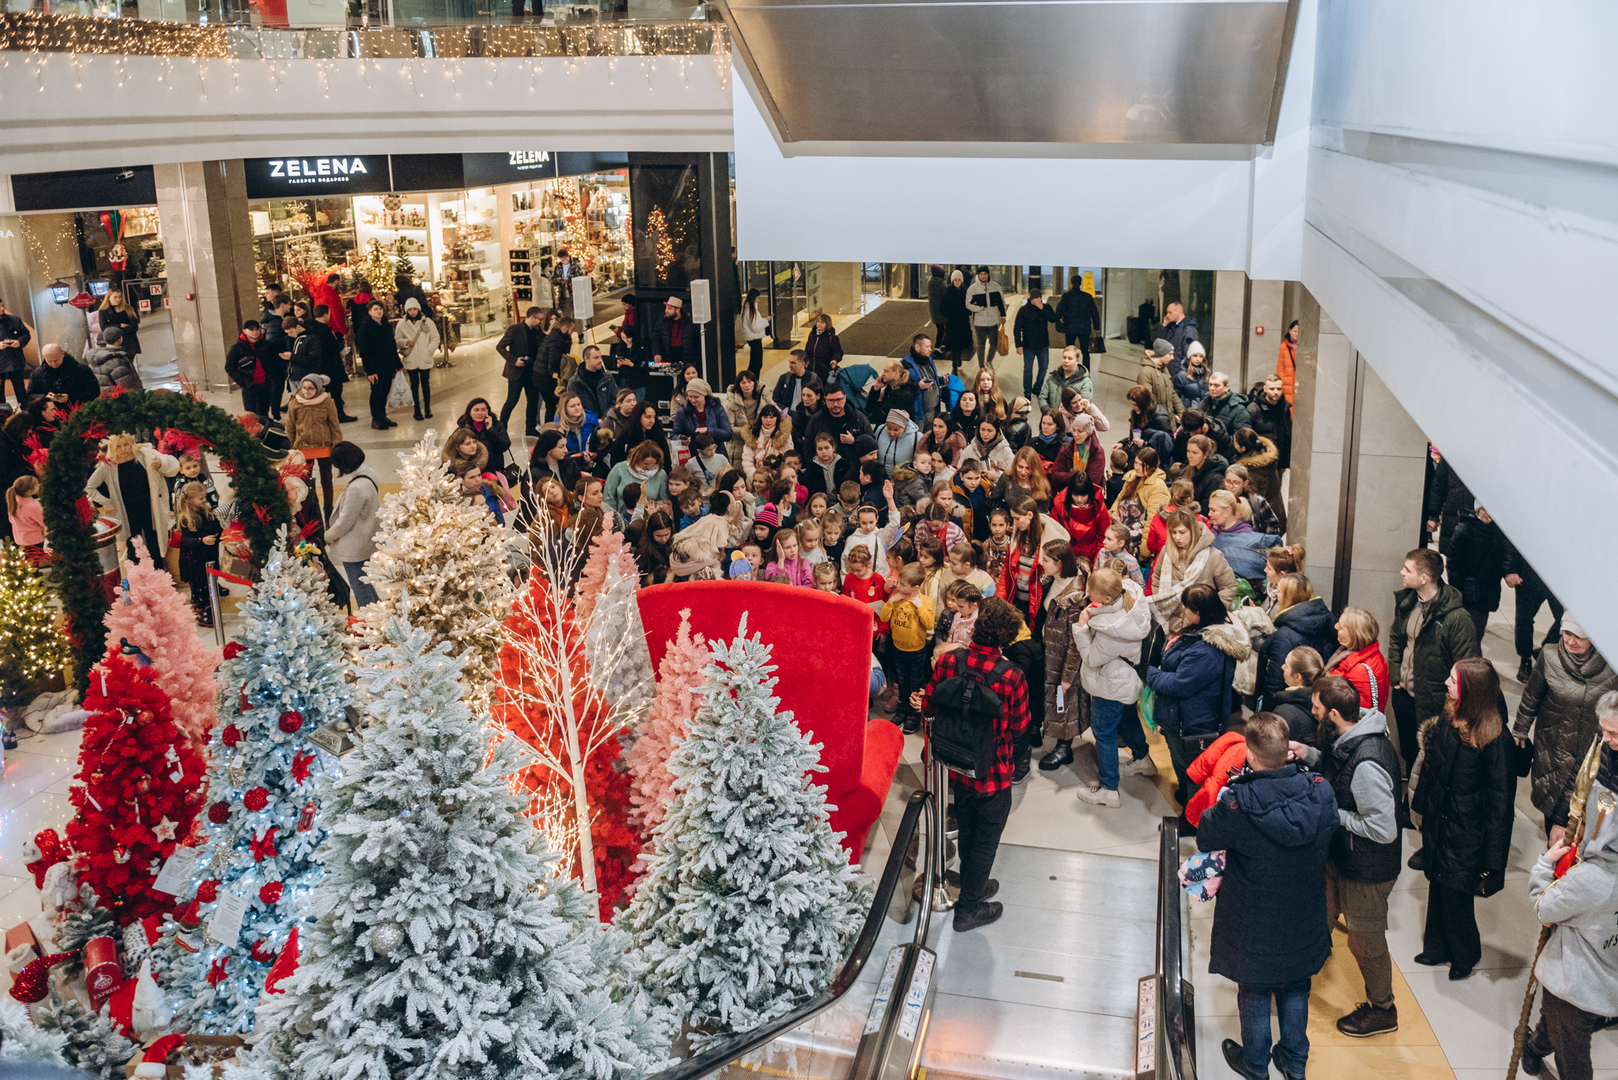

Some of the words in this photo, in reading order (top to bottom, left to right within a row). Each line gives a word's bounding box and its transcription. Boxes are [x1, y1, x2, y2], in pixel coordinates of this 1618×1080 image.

[508, 151, 550, 165] ZELENA
[268, 157, 368, 178] ZELENA
[93, 985, 121, 1000] EXPRESS
